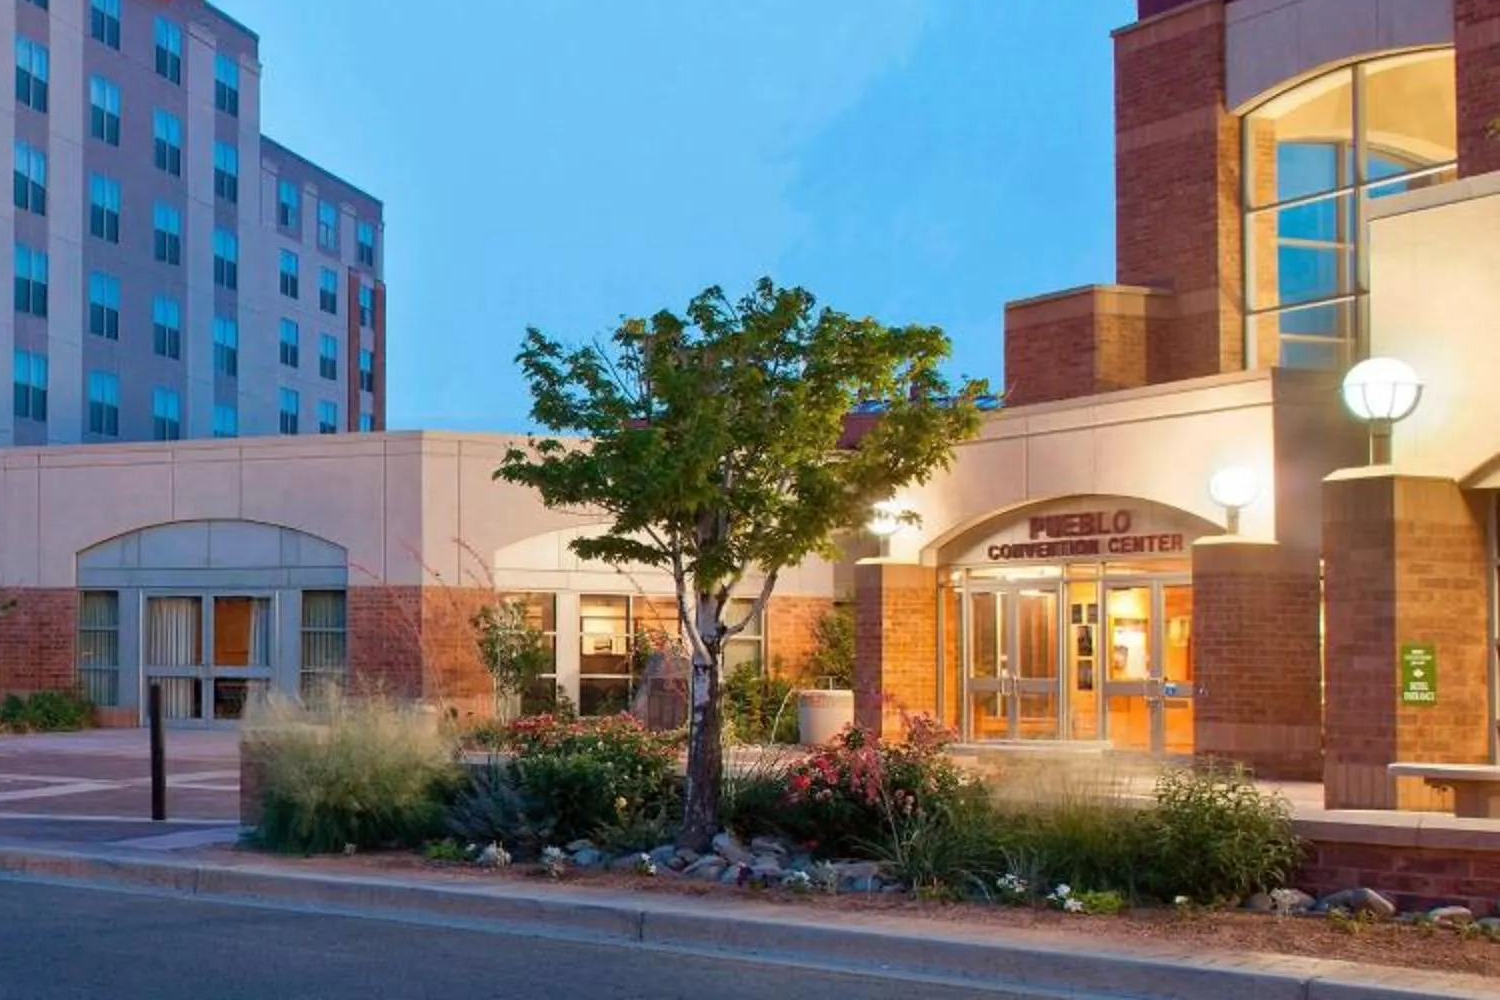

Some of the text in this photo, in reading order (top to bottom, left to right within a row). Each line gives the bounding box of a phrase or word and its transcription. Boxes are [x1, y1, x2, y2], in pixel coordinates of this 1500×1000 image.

[1029, 509, 1132, 539] PUEBLO
[988, 534, 1183, 560] CONVENTION CENTER
